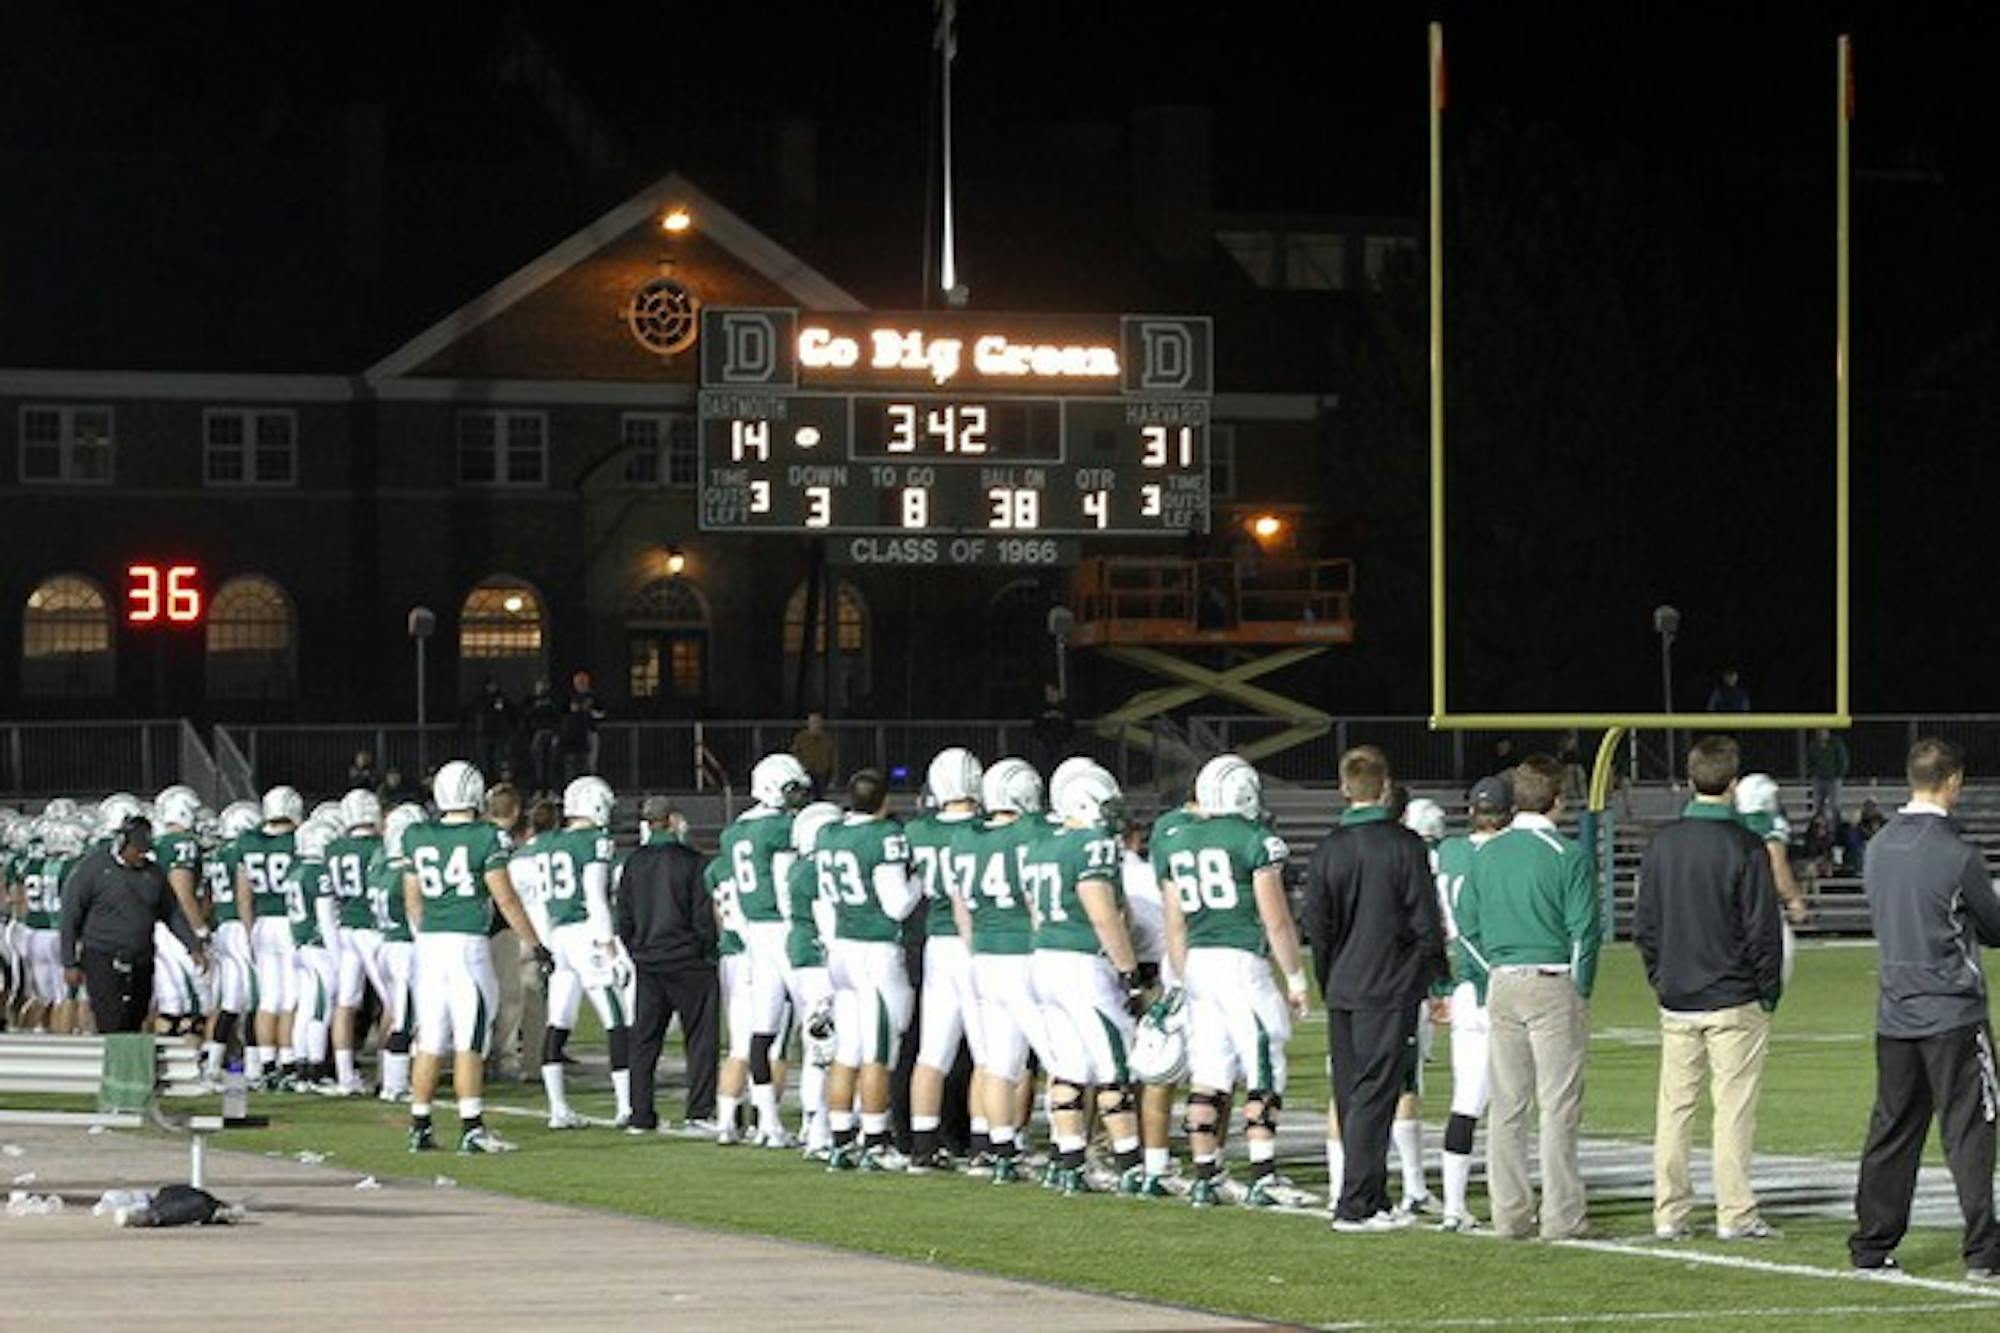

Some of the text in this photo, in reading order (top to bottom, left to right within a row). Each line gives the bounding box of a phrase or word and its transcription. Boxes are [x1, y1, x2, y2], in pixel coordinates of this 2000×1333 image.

[723, 314, 776, 382] D
[798, 328, 1120, 385] Go Big Green
[1142, 323, 1193, 388] D
[731, 420, 769, 461] 14
[1141, 426, 1191, 466] 31
[789, 466, 848, 485] DOWN
[871, 467, 935, 487] TO GO
[750, 480, 770, 513] 3
[805, 487, 831, 527] 3
[903, 488, 928, 528] 8
[988, 489, 1039, 528] 38
[1083, 490, 1107, 529] 4
[1141, 484, 1161, 516] 3
[851, 538, 1058, 563] CLASS OF 1966
[128, 566, 199, 621] 36
[328, 854, 363, 897] 13
[415, 846, 475, 897] 64
[733, 840, 757, 893] 6
[815, 850, 867, 905] 63
[954, 852, 1014, 908] 74
[1170, 849, 1238, 912] 68
